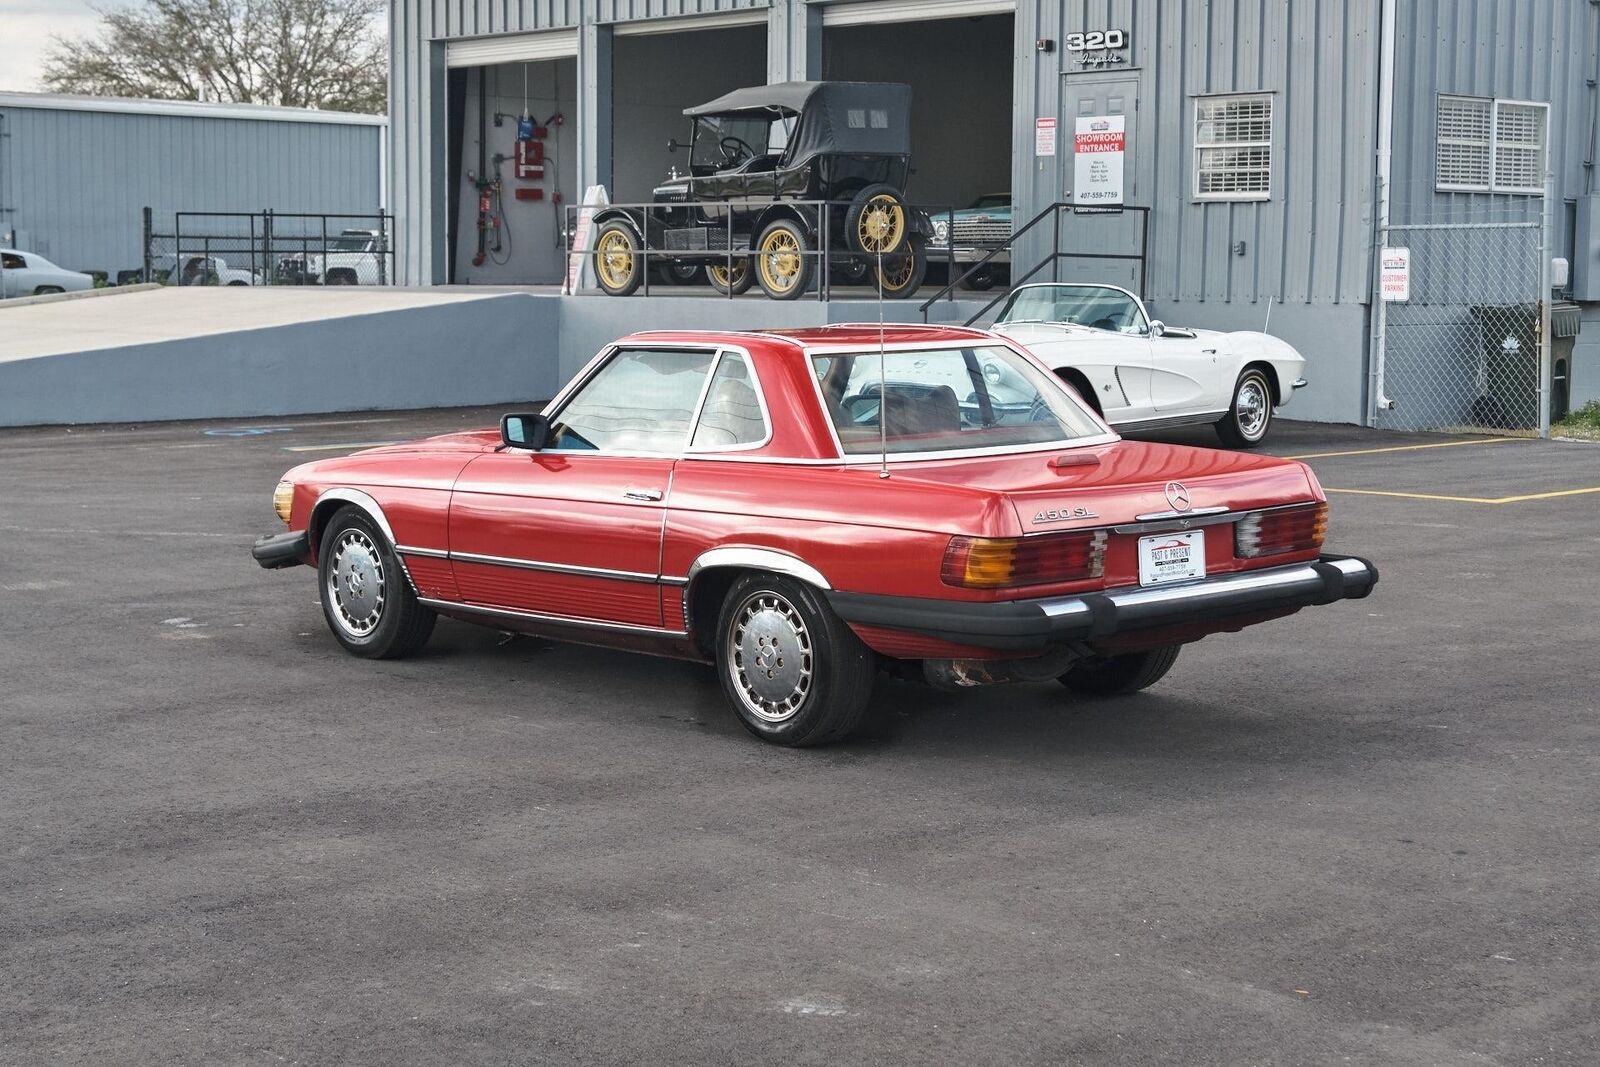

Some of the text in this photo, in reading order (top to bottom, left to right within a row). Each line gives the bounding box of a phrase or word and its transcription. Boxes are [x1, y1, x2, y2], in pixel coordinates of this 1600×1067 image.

[1066, 29, 1124, 51] 320
[1073, 52, 1121, 67] Impala
[1076, 133, 1123, 144] SHOWROOM
[1079, 142, 1119, 153] ENTRANCE
[1382, 274, 1408, 282] CUSTOMER
[1384, 284, 1404, 292] PARKING
[1034, 507, 1095, 520] 450 SL
[1151, 549, 1163, 561] PAST
[1170, 547, 1191, 558] PRESENT
